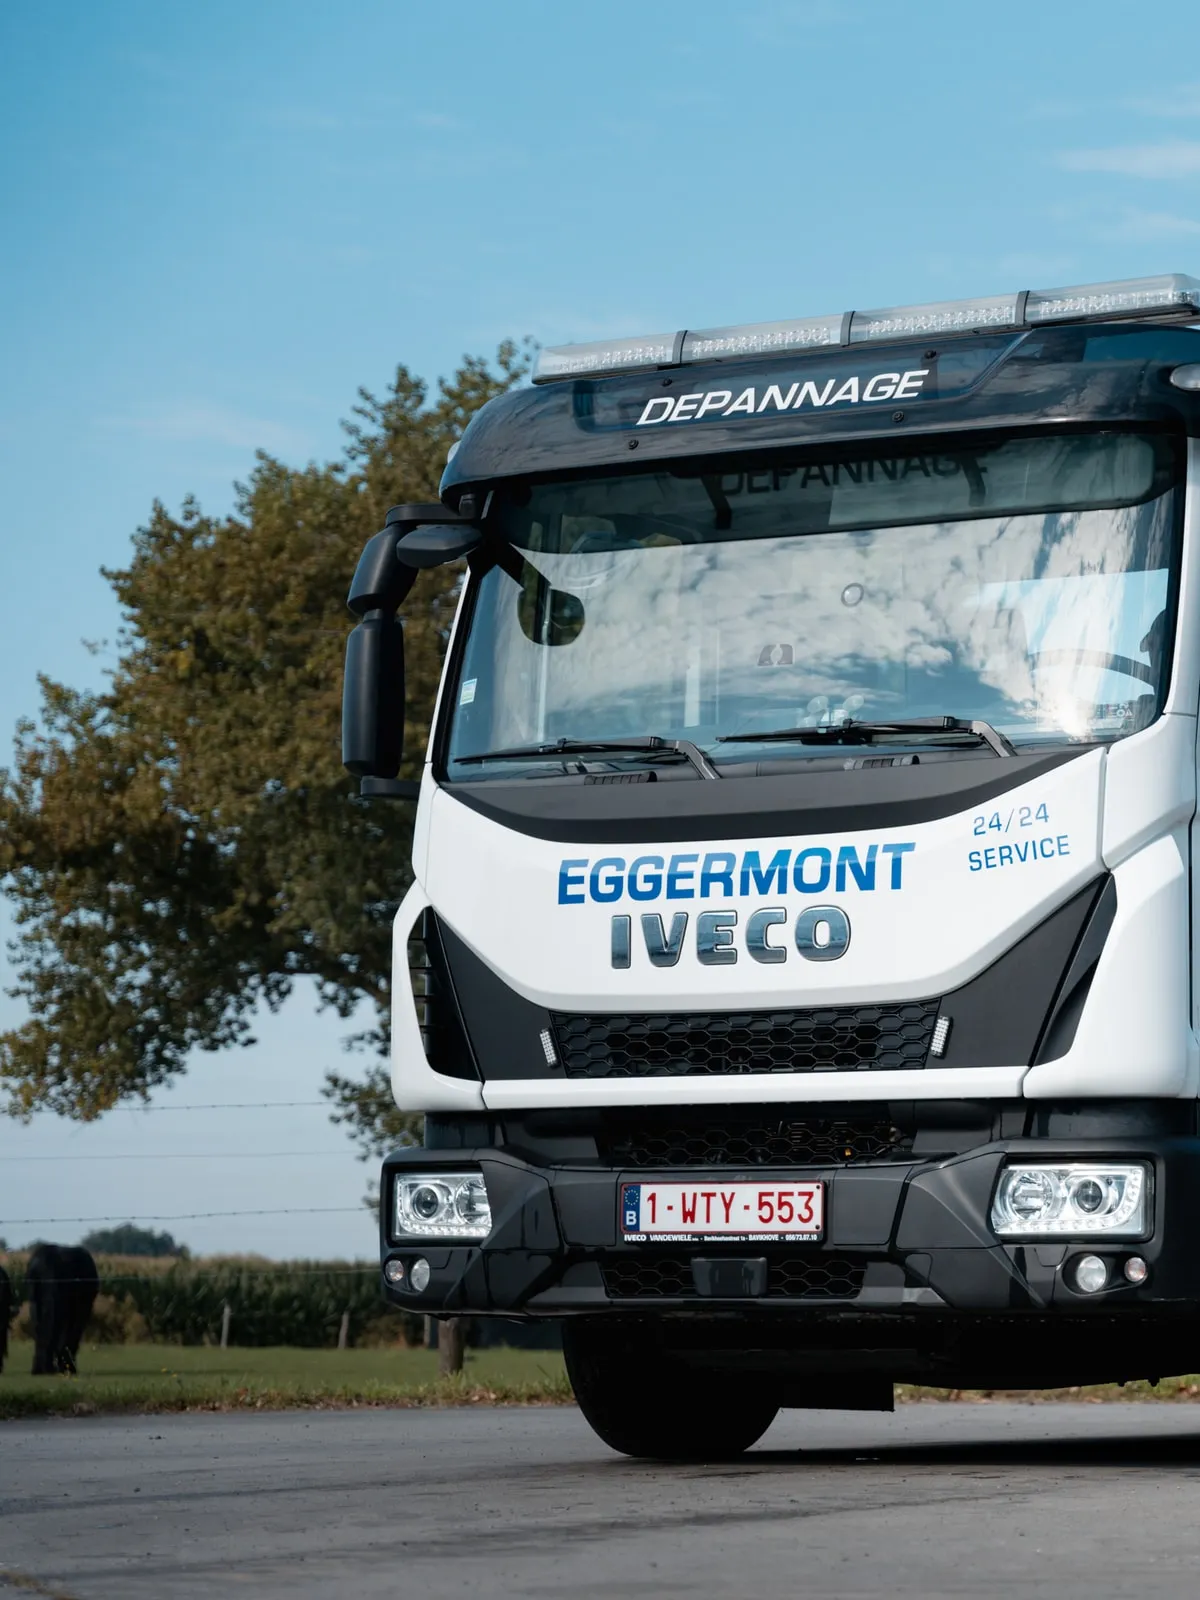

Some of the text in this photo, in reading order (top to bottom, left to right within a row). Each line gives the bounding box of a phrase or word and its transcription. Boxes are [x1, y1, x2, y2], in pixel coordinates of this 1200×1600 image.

[636, 369, 930, 427] DEPANNAGE
[973, 803, 1049, 836] 24/24
[968, 834, 1070, 872] SERVICE
[558, 842, 916, 905] EGGERMONT
[610, 904, 852, 970] IVECO
[626, 1211, 637, 1225] B
[646, 1191, 815, 1225] 1-WTY-553
[624, 1233, 647, 1242] IVECO
